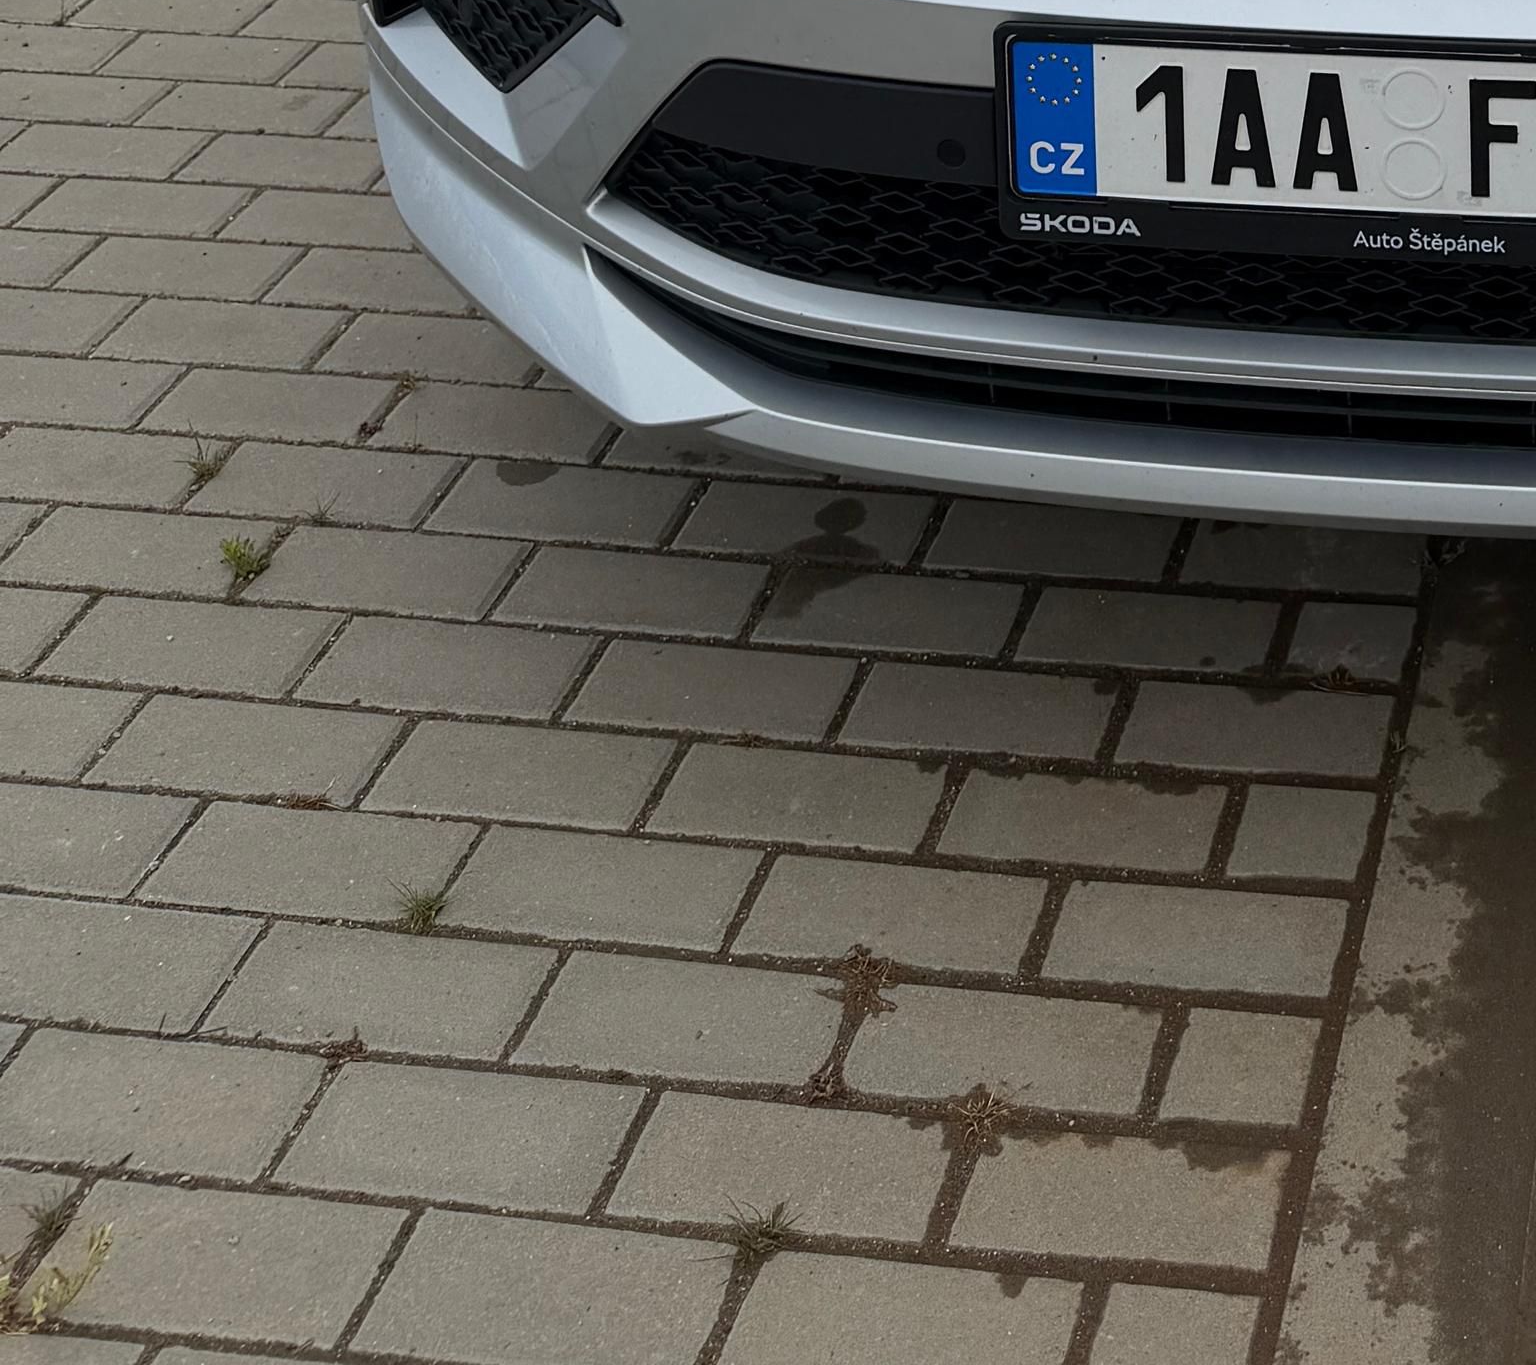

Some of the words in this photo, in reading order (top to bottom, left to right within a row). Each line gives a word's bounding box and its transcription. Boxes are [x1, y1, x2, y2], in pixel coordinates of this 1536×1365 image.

[1135, 65, 1359, 193] 1AA
[1029, 140, 1086, 176] CZ
[1353, 230, 1404, 250] Auto
[1408, 227, 1506, 256] Štěpánek
